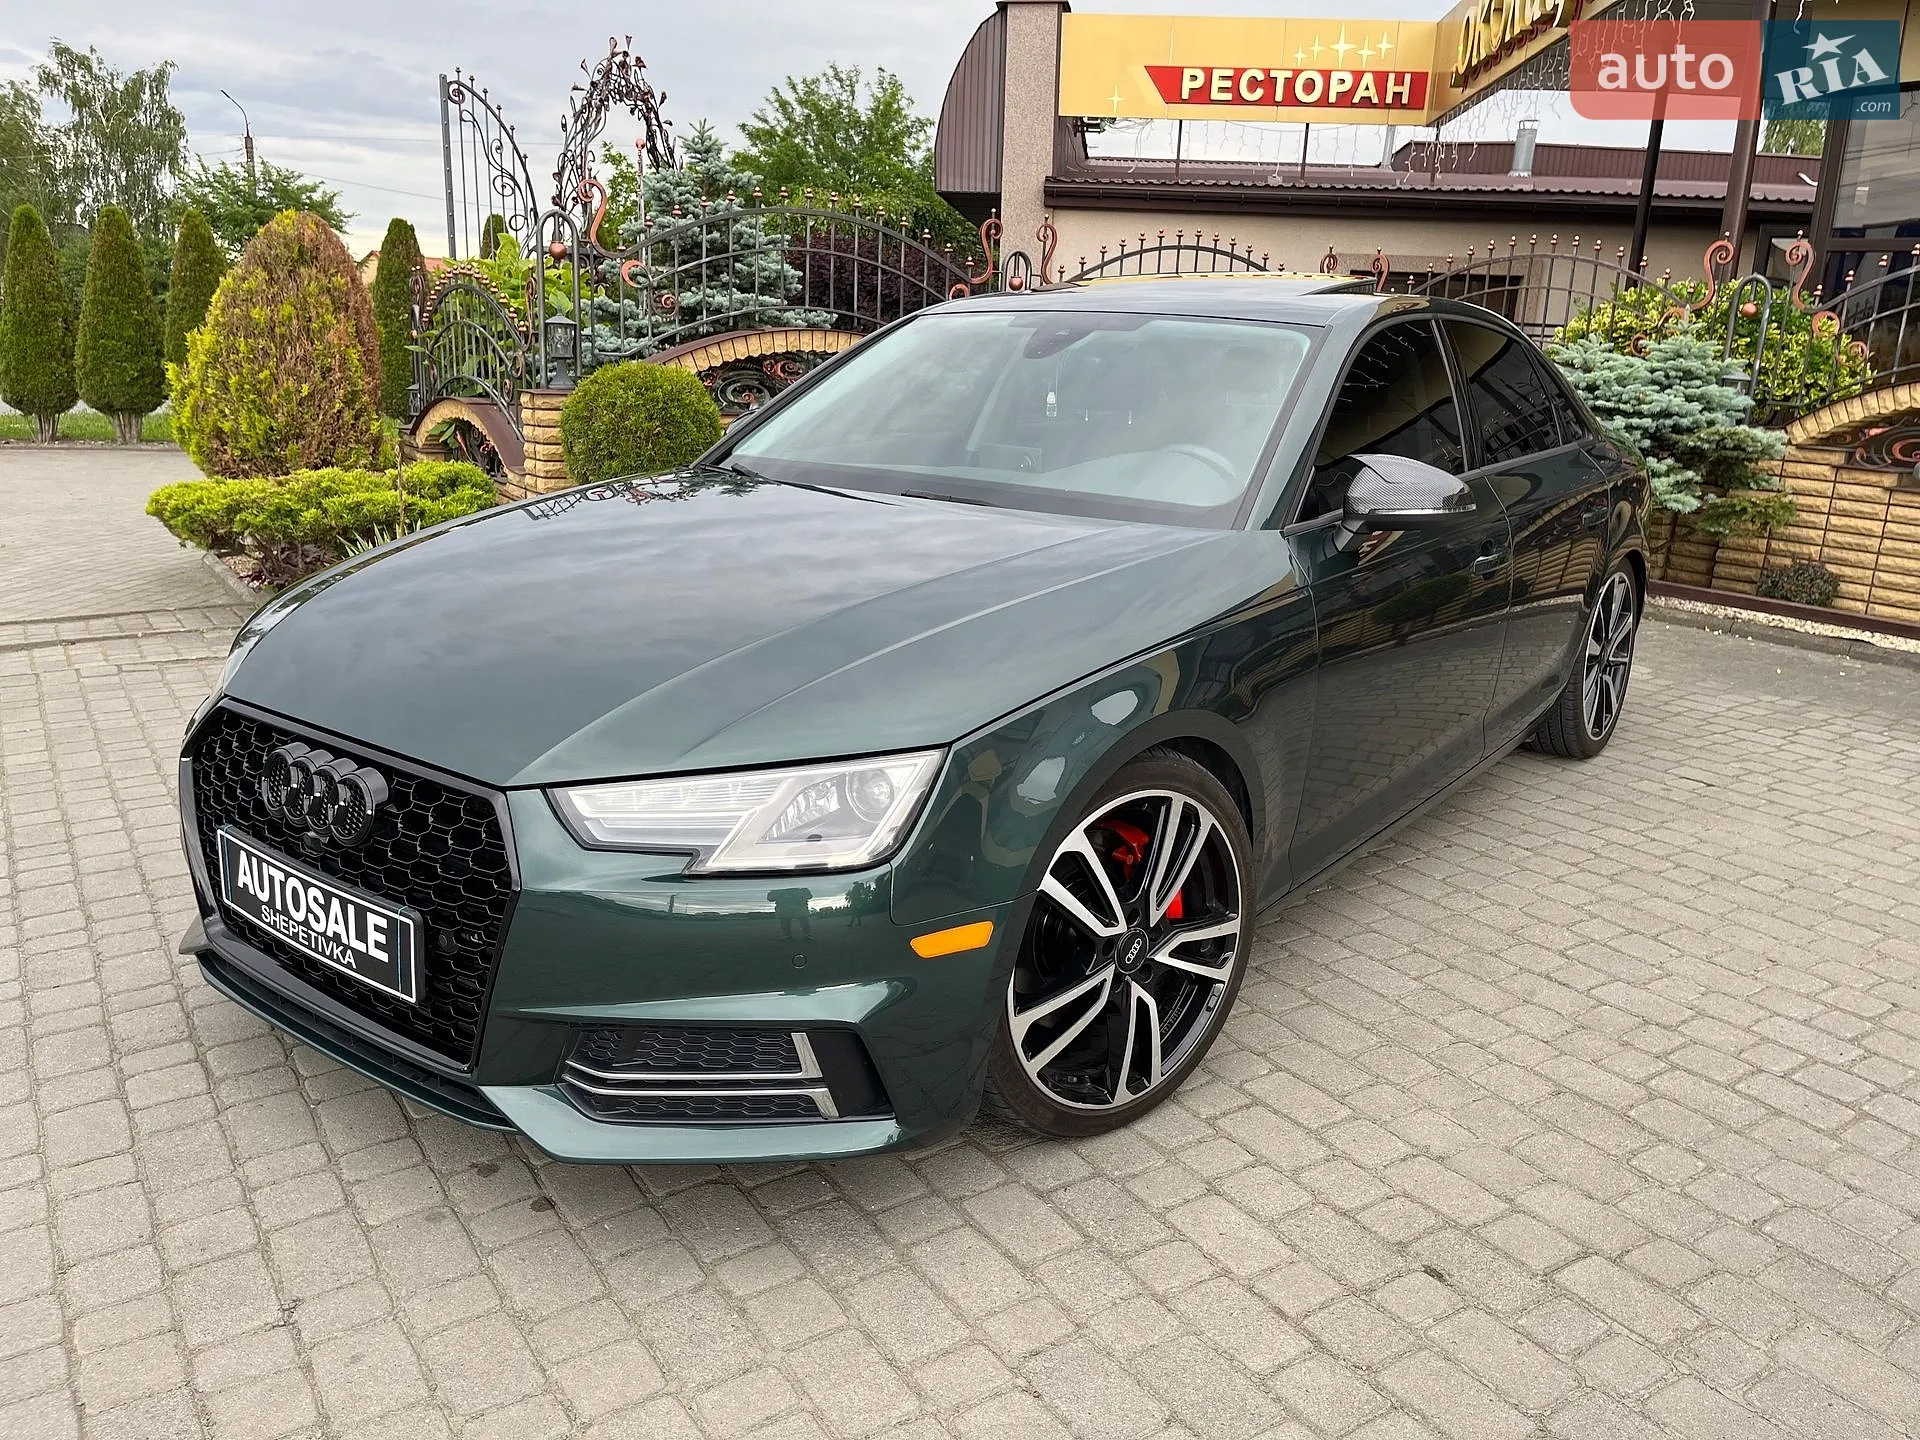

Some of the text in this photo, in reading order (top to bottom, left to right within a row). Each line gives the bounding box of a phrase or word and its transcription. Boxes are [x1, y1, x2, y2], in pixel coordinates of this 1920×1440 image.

[1181, 67, 1412, 105] РЕСТОРАН
[237, 849, 389, 963] AUTOSALE
[261, 904, 357, 969] SHEPETIVKA
